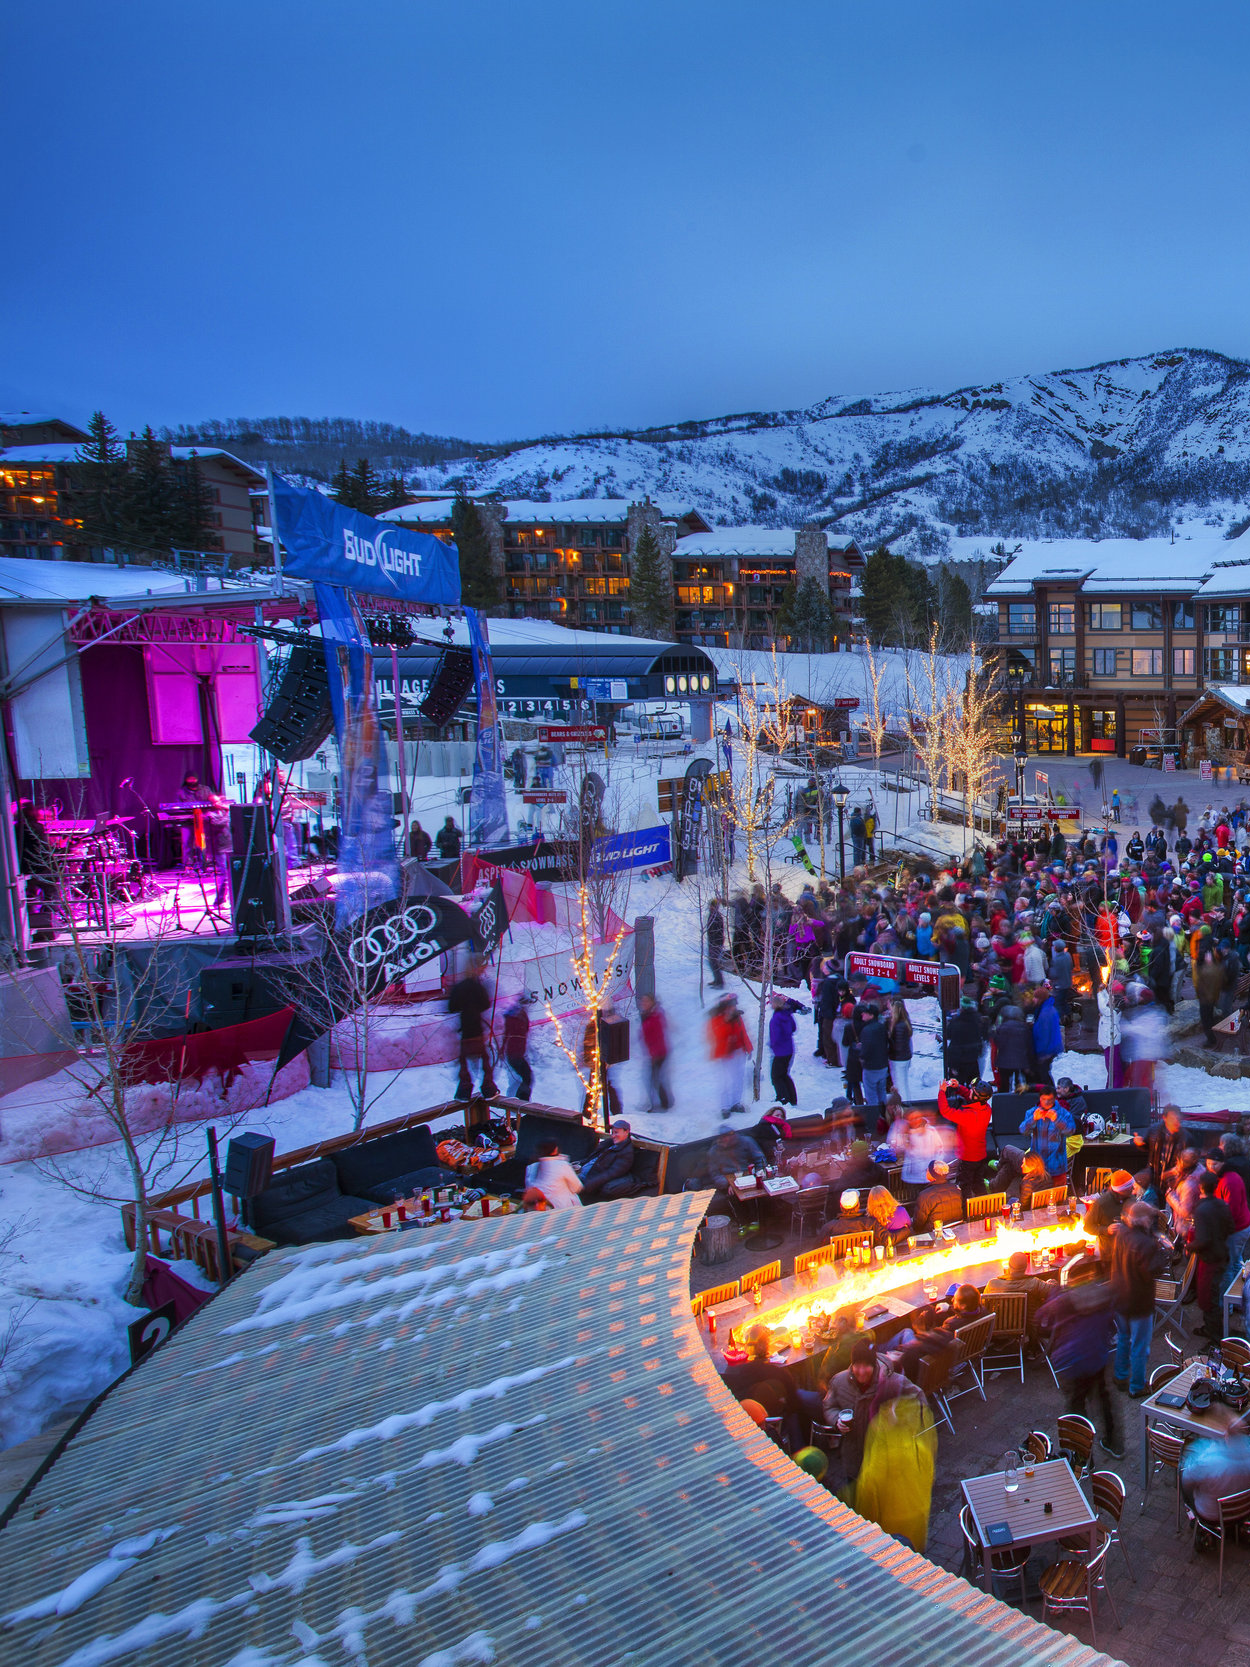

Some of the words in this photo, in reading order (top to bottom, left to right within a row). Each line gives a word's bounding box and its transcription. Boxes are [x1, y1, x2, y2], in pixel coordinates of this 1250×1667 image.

[343, 528, 376, 567] BUD
[382, 542, 422, 577] LIGHT
[508, 702, 517, 711] 2
[526, 701, 535, 711] 3
[544, 701, 553, 710] 4
[563, 700, 571, 710] 5
[622, 842, 660, 858] LIGHT
[854, 957, 867, 966] ADULT
[868, 958, 895, 970] SNOWBOARD
[908, 964, 922, 973] ADULT
[859, 966, 875, 976] LEVELS
[877, 968, 881, 976] 2
[914, 975, 931, 983] LEVELS
[933, 976, 937, 984] 5
